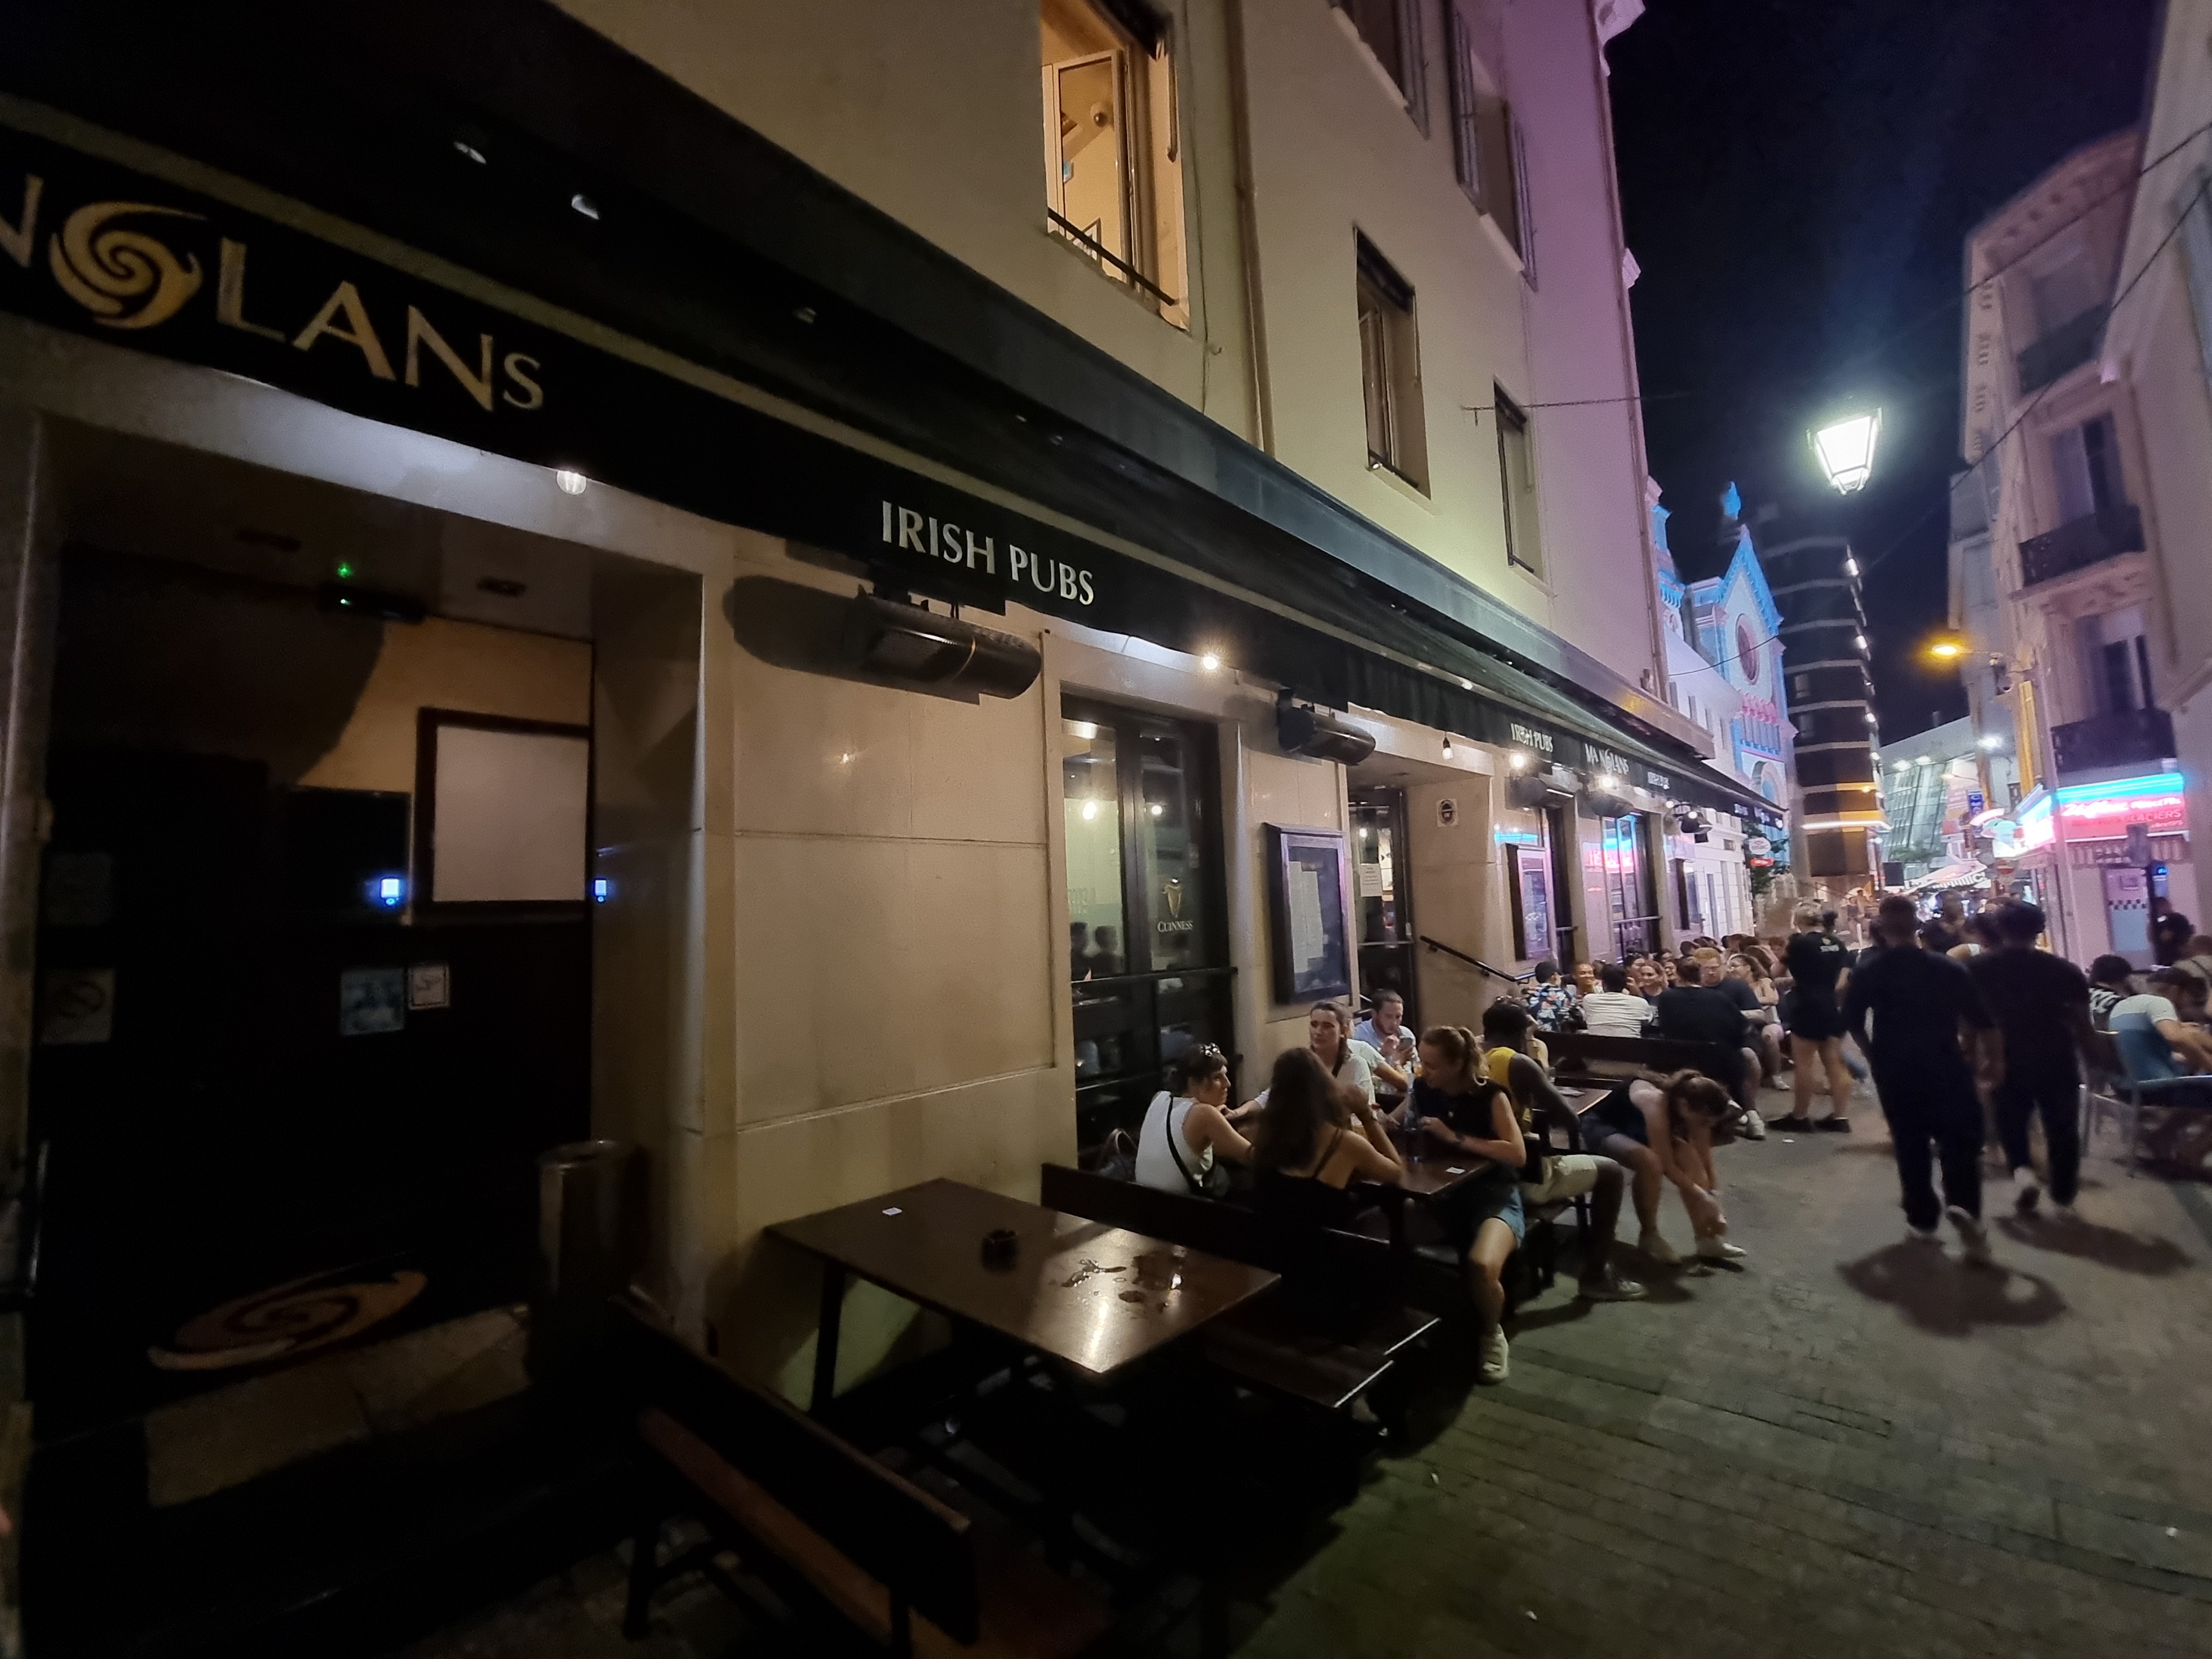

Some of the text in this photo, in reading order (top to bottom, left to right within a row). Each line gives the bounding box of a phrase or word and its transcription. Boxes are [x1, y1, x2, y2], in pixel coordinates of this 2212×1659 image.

[882, 500, 1094, 606] IRISH PUBS
[1533, 731, 1553, 753] PUBS
